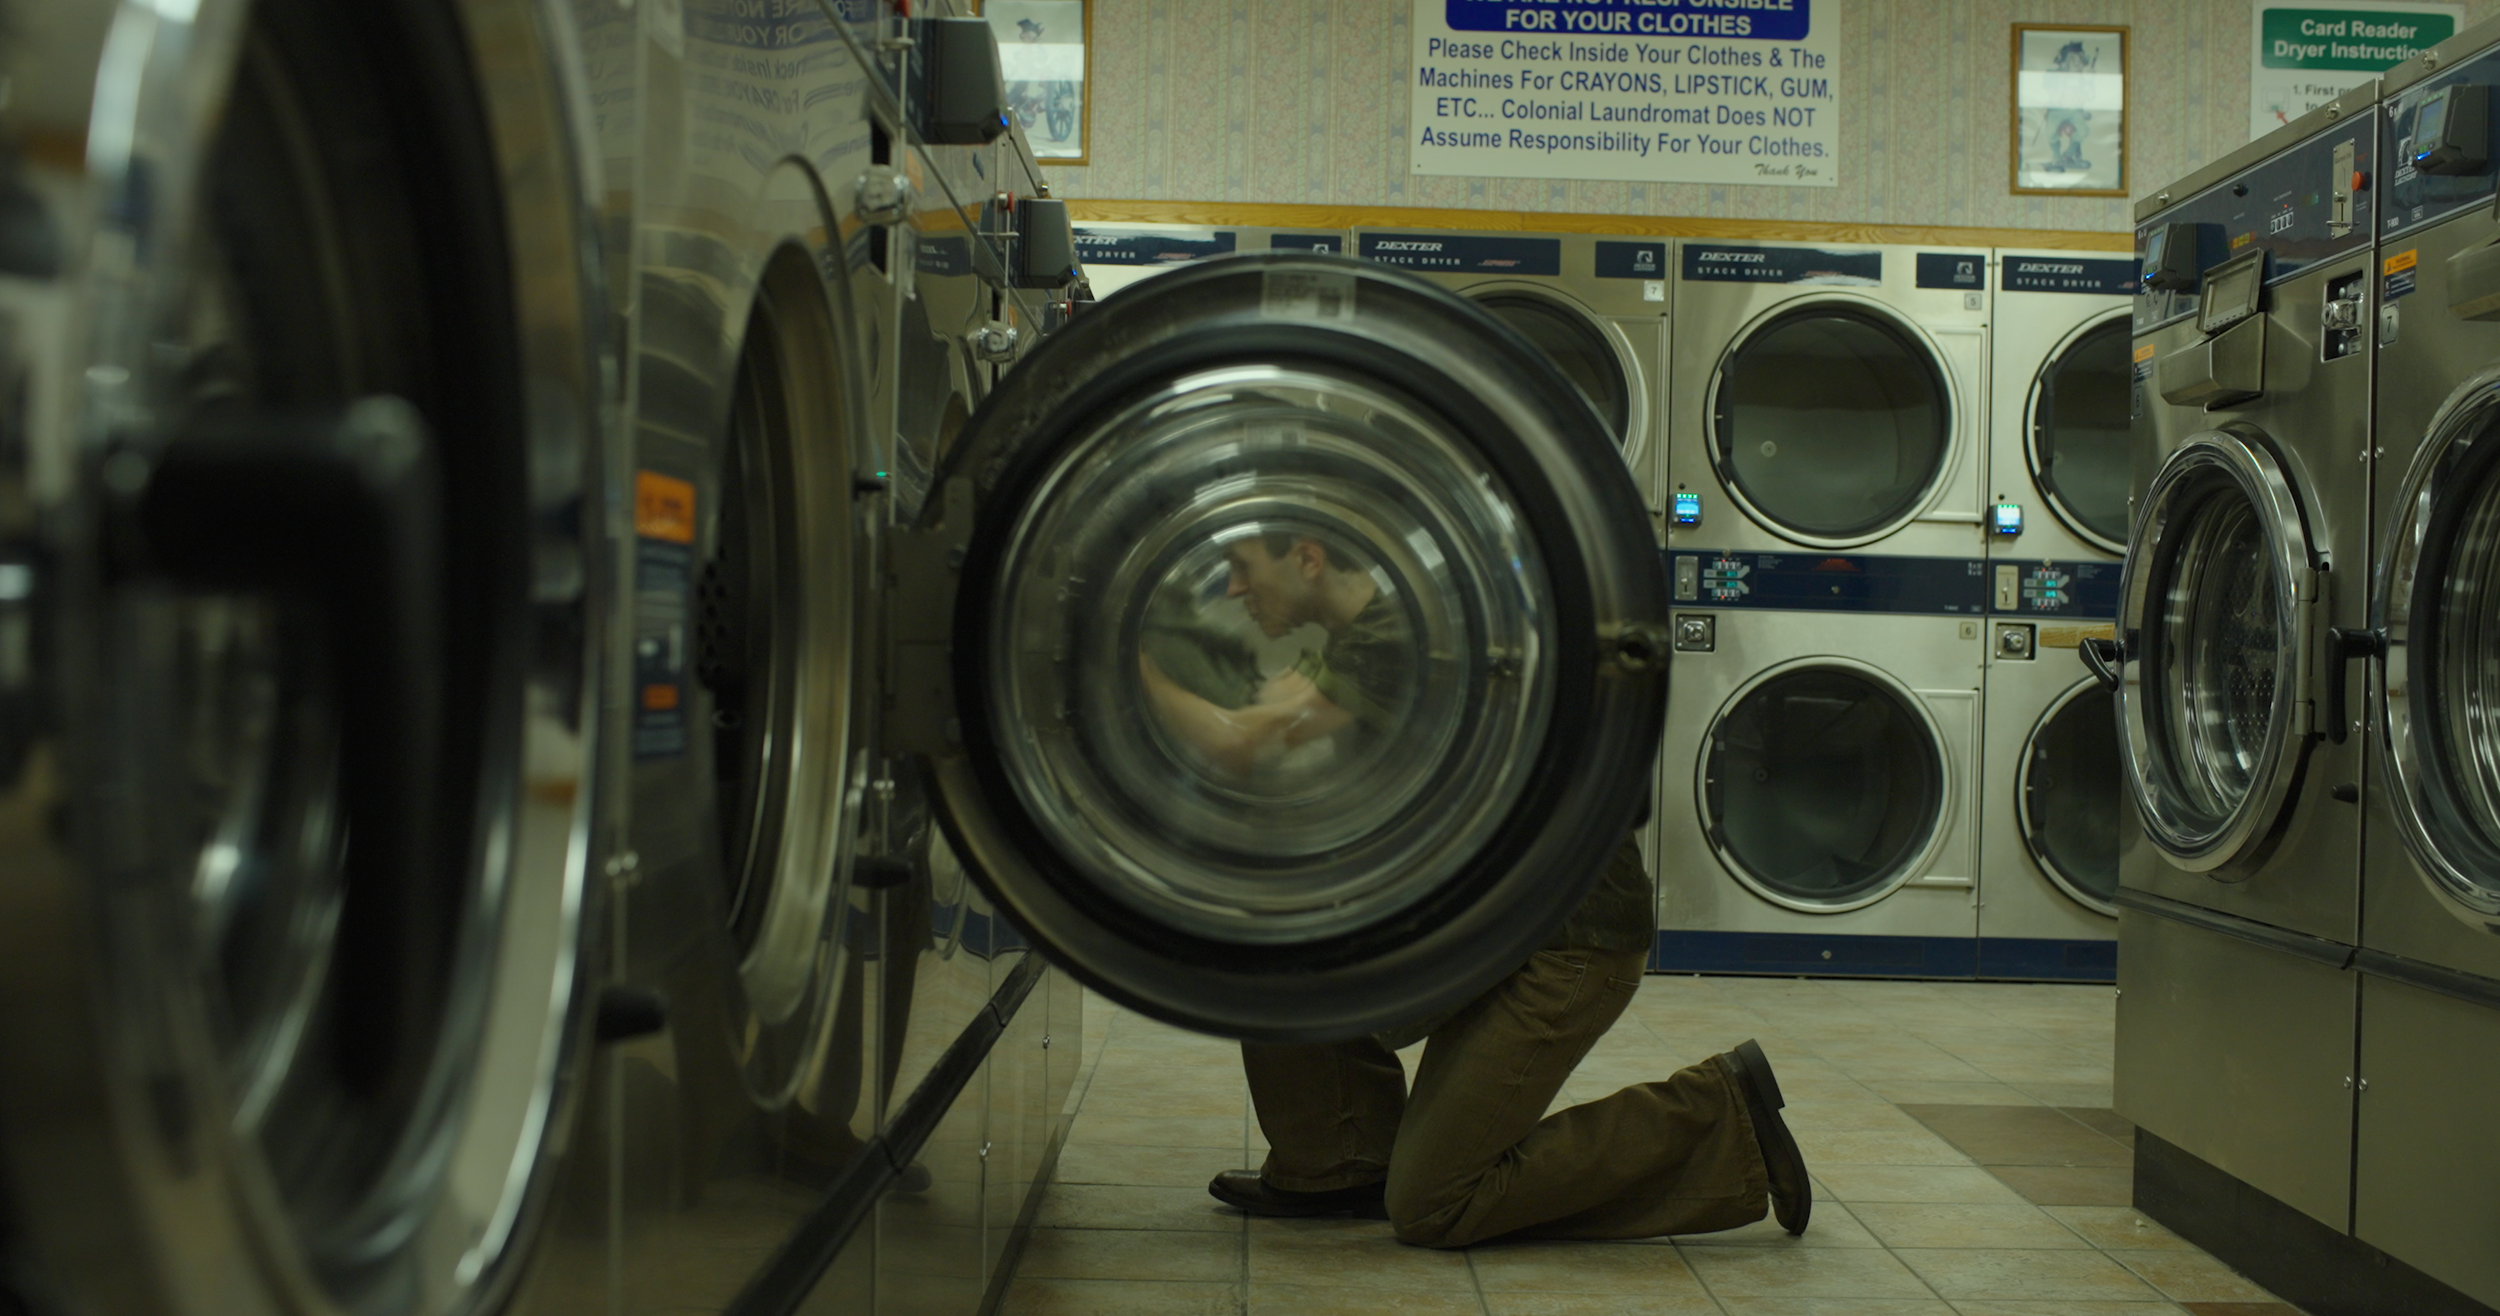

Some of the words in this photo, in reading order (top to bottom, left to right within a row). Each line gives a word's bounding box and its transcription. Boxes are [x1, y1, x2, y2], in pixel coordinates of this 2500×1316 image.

[1505, 9, 1557, 31] FOR
[1562, 10, 1632, 32] YOUR
[1637, 12, 1752, 36] CLOTHES
[2301, 19, 2346, 37] Card
[2351, 20, 2418, 39] Reader
[1428, 38, 1494, 59] Please
[1500, 40, 1562, 61] Check
[1569, 42, 1629, 63] Inside
[1636, 43, 1681, 64] Your
[1687, 45, 1762, 66] Clothes
[1769, 47, 1783, 67] &
[1790, 48, 1826, 69] The
[2274, 40, 2327, 61] Dryer
[2331, 42, 2425, 61] Instructio
[1420, 67, 1514, 89] Machines
[1521, 70, 1554, 90] For
[1560, 71, 1668, 96] CRAYONS,
[1674, 75, 1773, 99] LIPSTICK,
[1780, 78, 1834, 101] GUM,
[2305, 84, 2335, 96] First
[1436, 97, 1495, 118] ETC...
[1502, 99, 1583, 120] Colonial
[1590, 102, 1710, 125] Laundromat
[1716, 105, 1766, 126] Does
[1773, 107, 1816, 128] NOT
[1421, 126, 1502, 149] Assume
[1509, 129, 1651, 157] Responsibility
[1657, 133, 1691, 153] For
[1697, 134, 1743, 155] Your
[1748, 136, 1830, 158] Clothes.
[1754, 163, 1790, 177] Thank
[1794, 164, 1819, 180] You
[1374, 240, 1443, 252] DEXTER
[1096, 251, 1136, 260] DRYER
[1374, 255, 1415, 265] STACK
[1421, 257, 1461, 266] DRYER
[1698, 251, 1766, 263] DEXTER
[1697, 266, 1738, 276] STACK
[1744, 268, 1784, 278] DRYER
[2017, 262, 2084, 275] DEXTER
[2016, 277, 2056, 287] STACK
[2062, 279, 2102, 289] DRYER
[2386, 315, 2393, 333] 7
